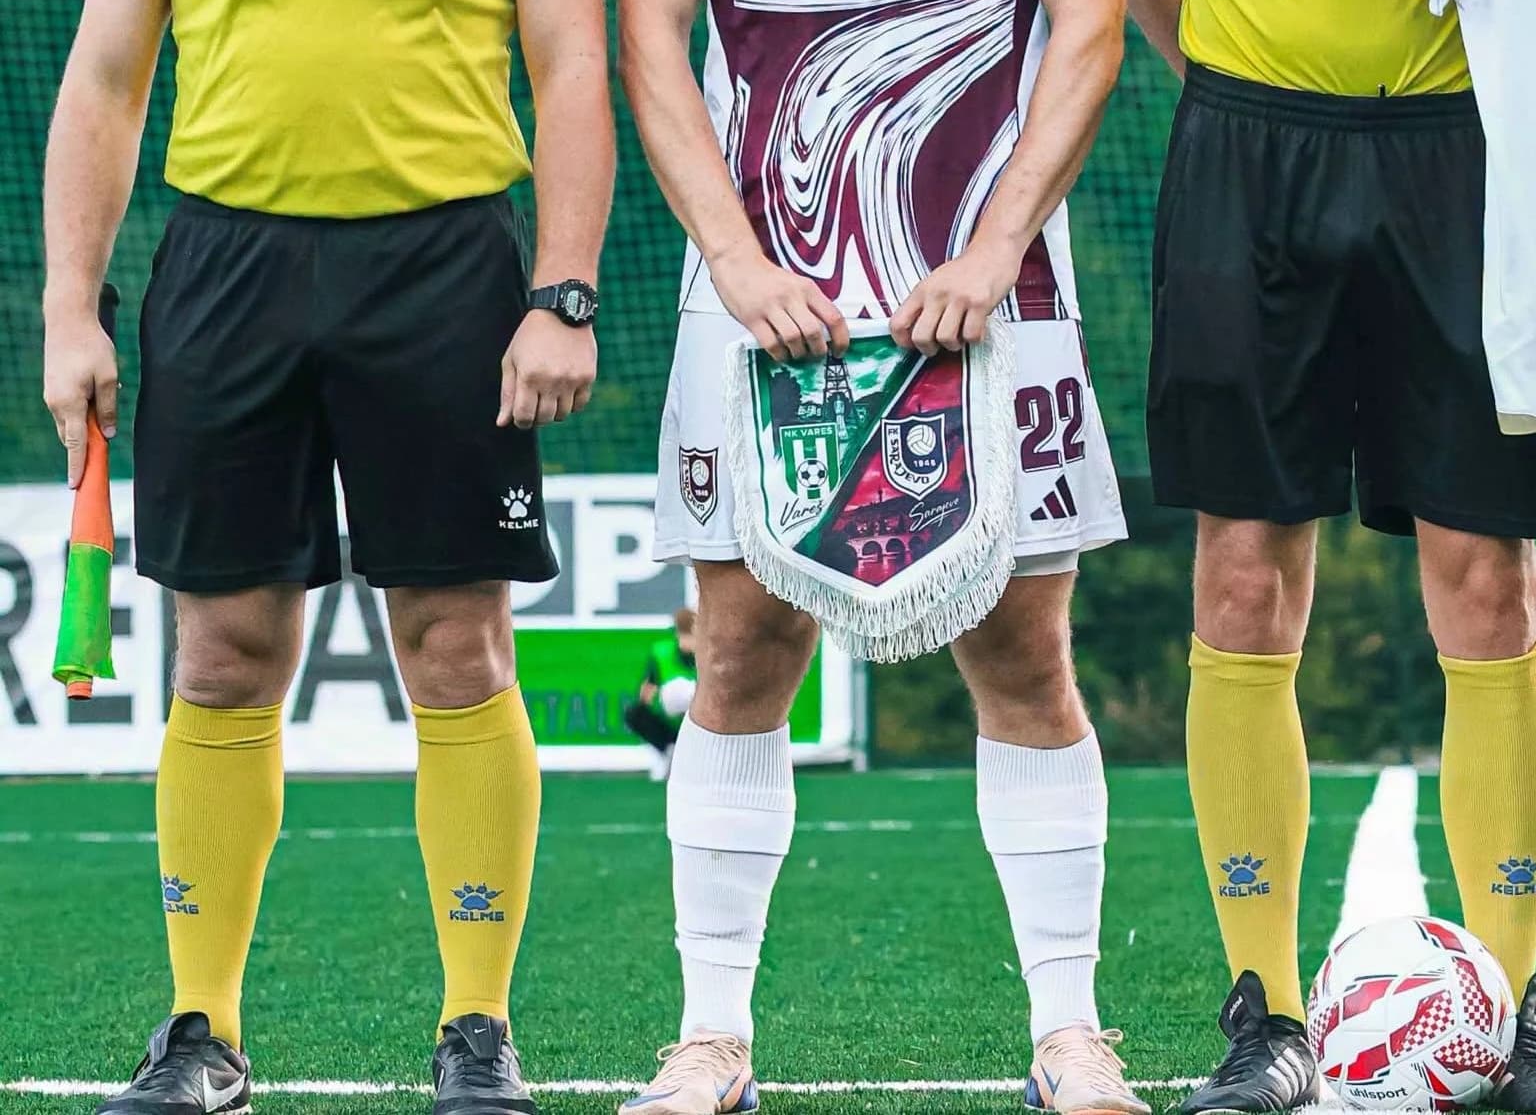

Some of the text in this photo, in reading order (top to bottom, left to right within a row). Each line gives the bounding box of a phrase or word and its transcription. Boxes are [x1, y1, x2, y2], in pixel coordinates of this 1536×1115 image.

[1014, 376, 1085, 473] 22
[784, 429, 798, 438] NK
[498, 518, 540, 530] KELME
[1219, 881, 1271, 897] KELME
[449, 910, 505, 922] KELME
[1349, 1087, 1409, 1101] uhlsport
